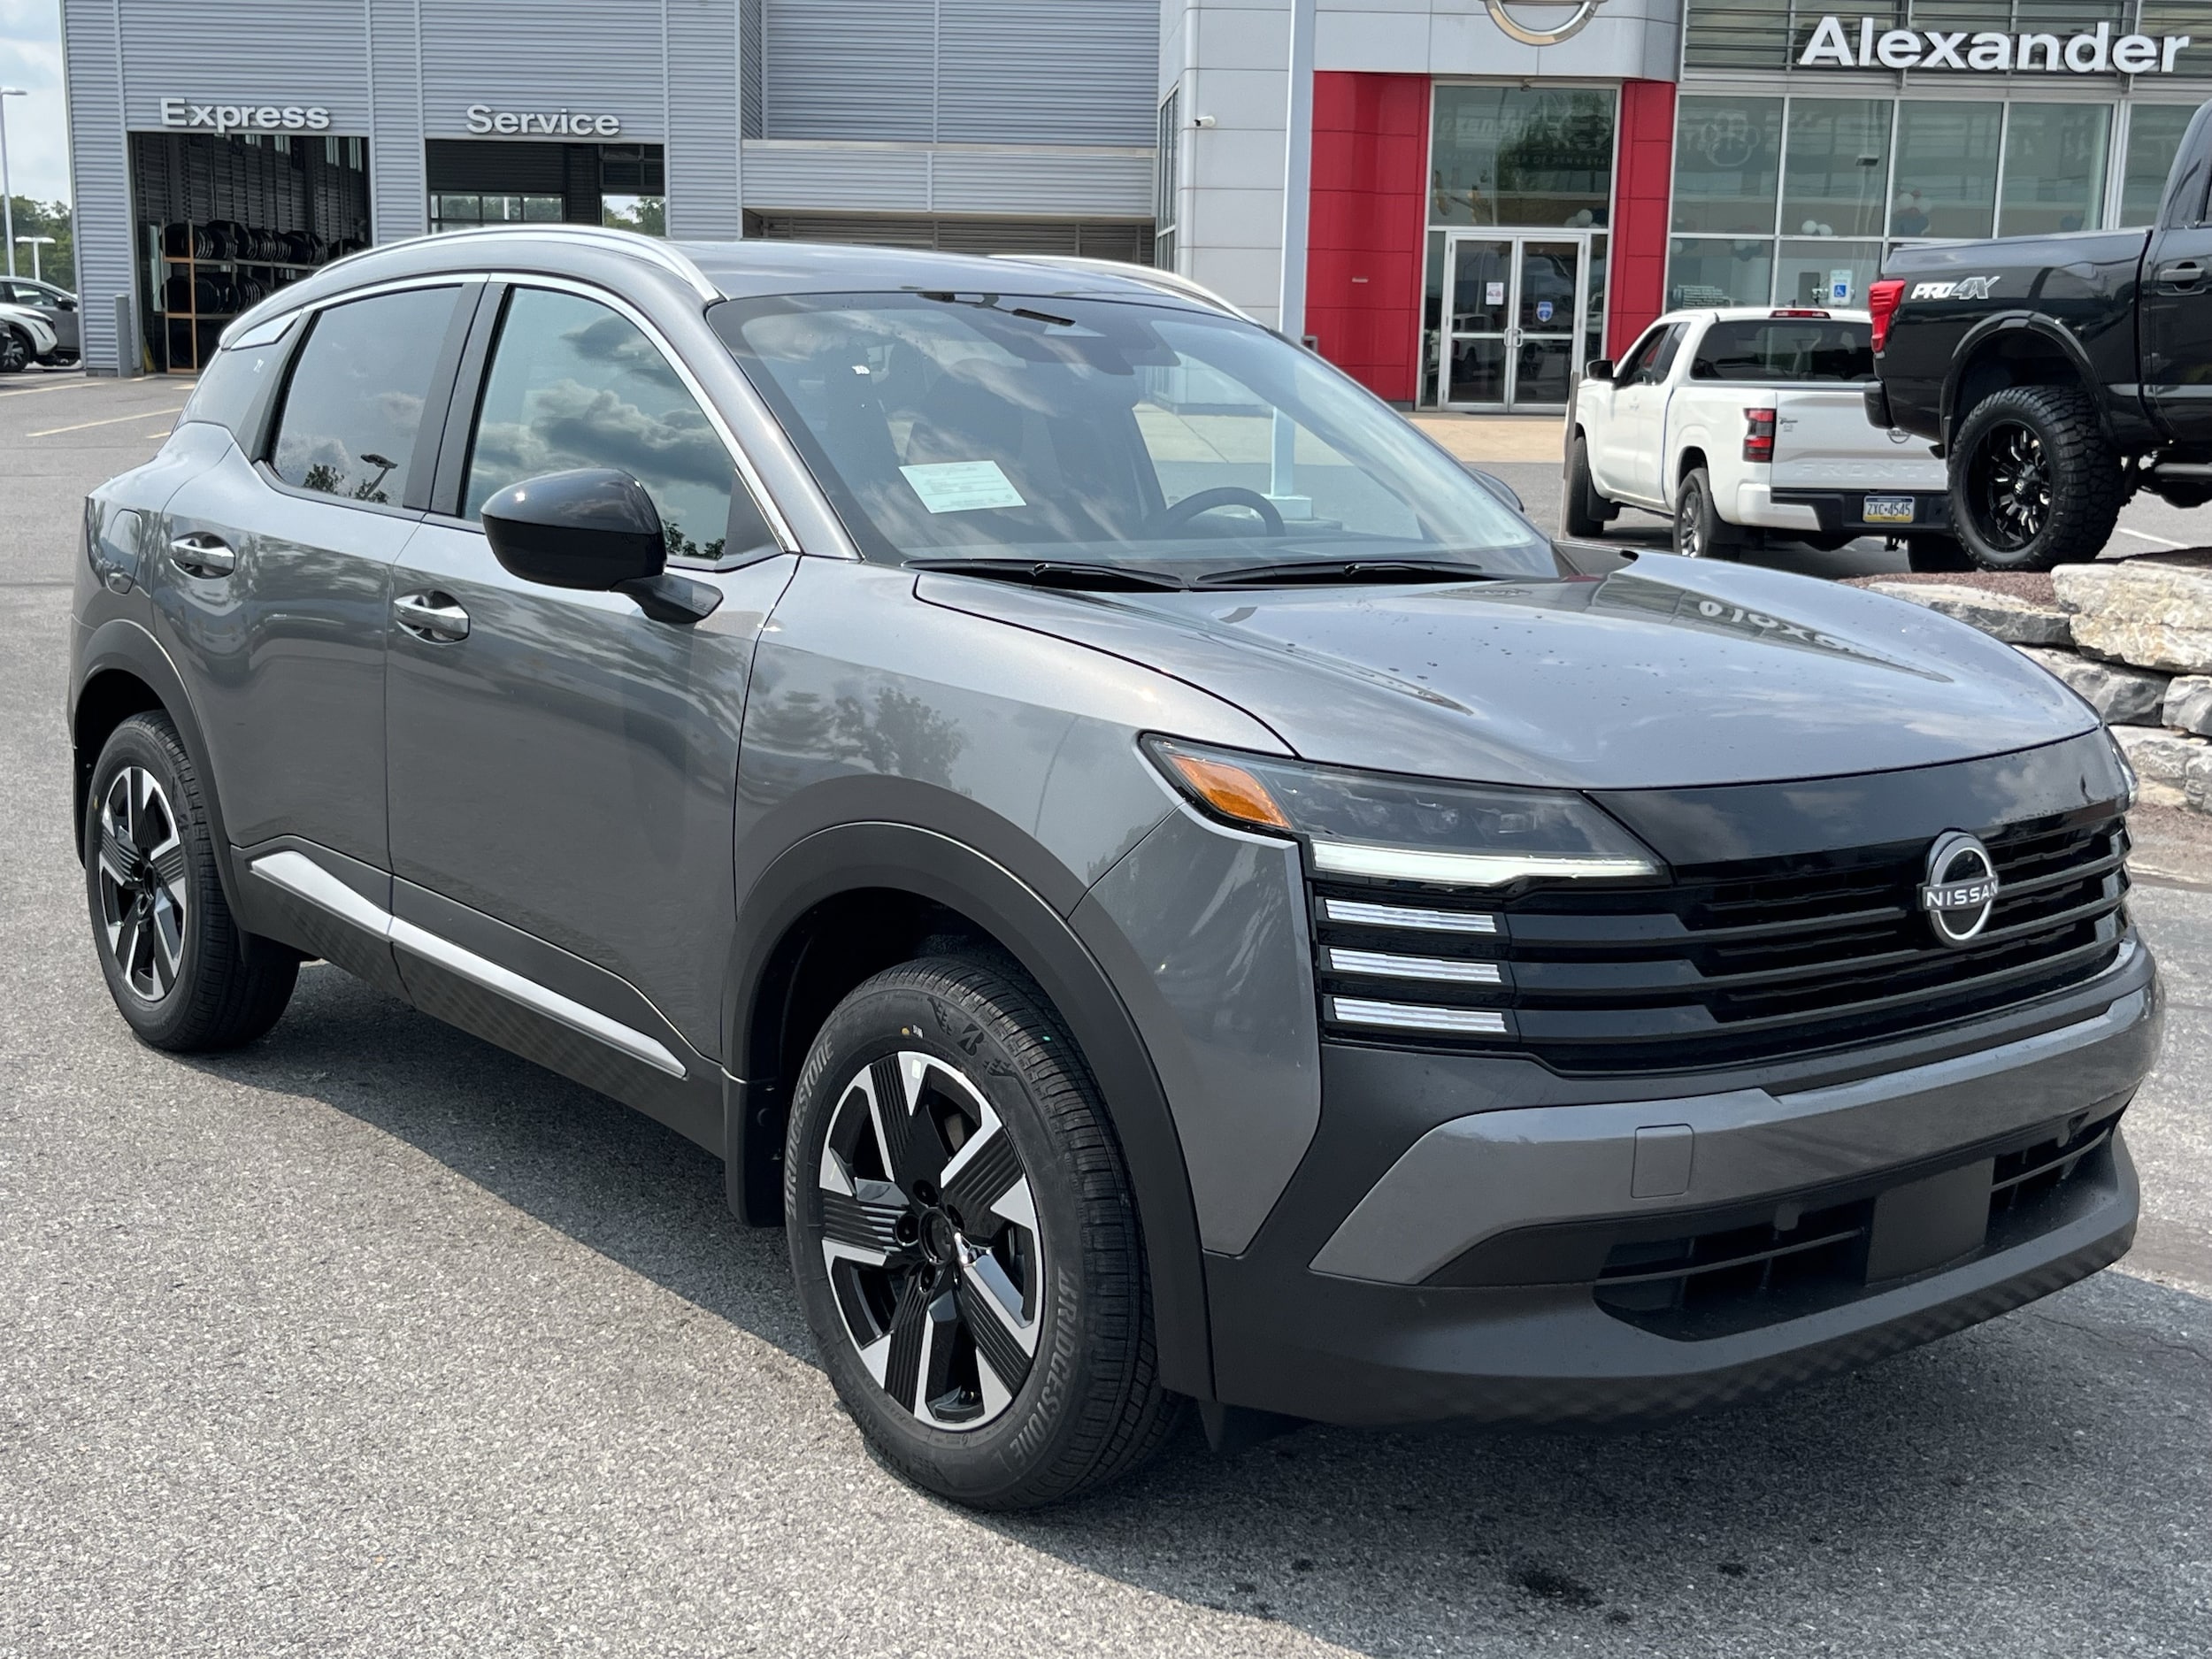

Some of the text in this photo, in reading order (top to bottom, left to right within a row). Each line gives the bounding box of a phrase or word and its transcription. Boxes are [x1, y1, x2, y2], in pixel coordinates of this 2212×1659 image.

[1798, 15, 2190, 73] Alexander
[159, 97, 330, 133] Express
[465, 104, 620, 136] Service
[1926, 881, 1999, 907] NISSAN
